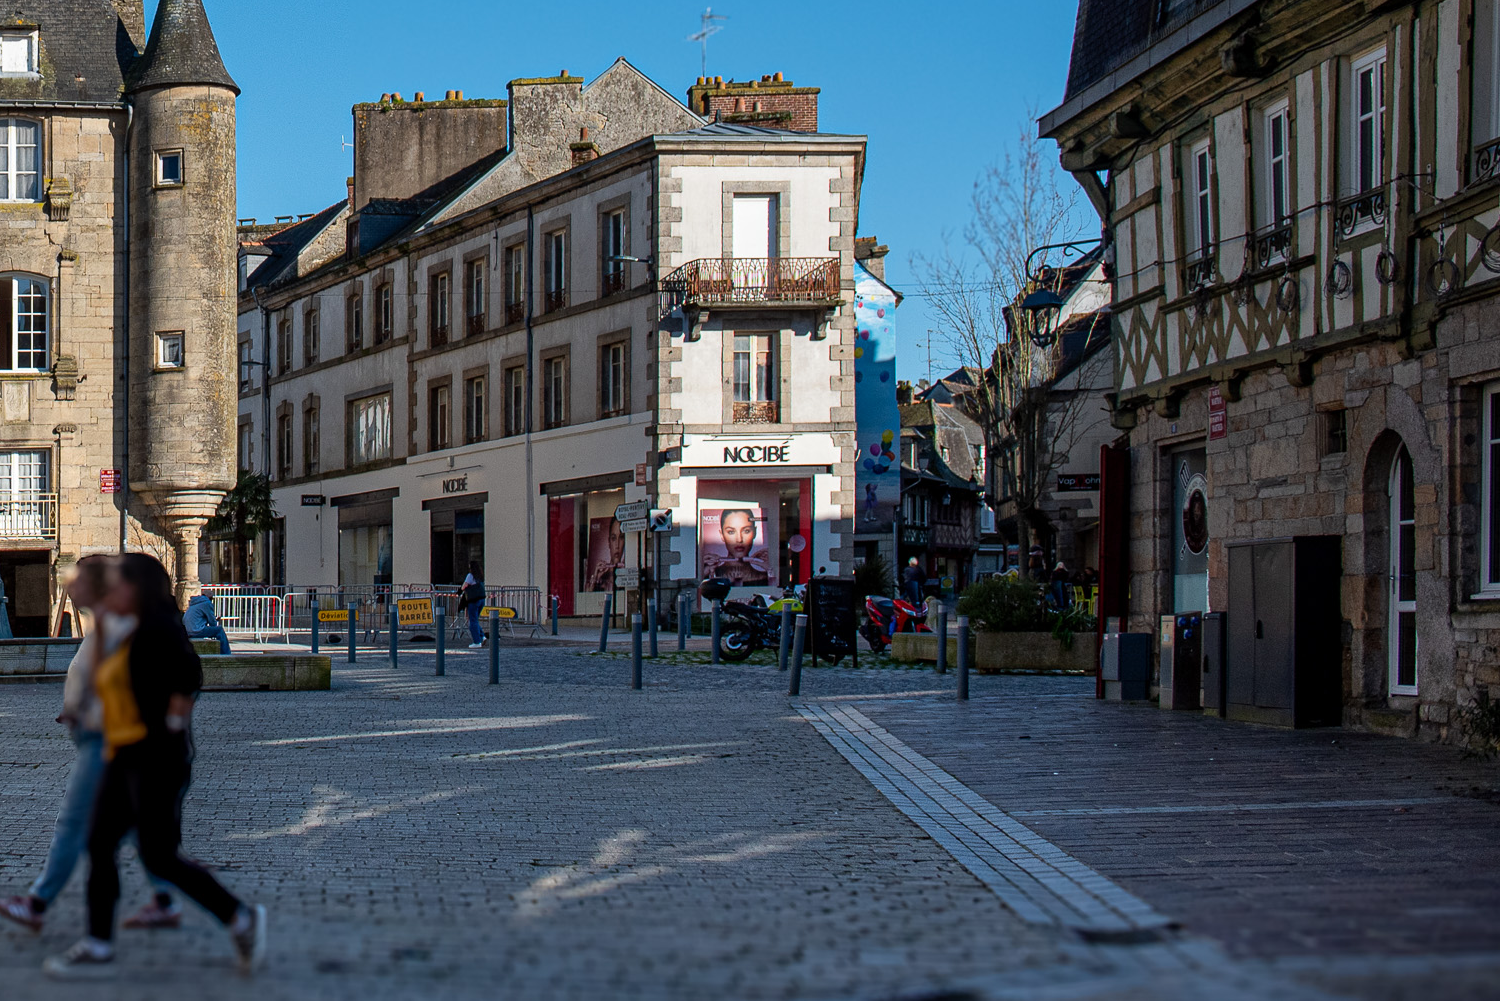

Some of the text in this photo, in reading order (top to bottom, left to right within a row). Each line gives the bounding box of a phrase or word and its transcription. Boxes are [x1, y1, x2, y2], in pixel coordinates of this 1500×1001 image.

[723, 440, 790, 463] NOCIBÉ
[442, 473, 468, 494] NOCIBÉ
[401, 602, 429, 611] ROUTE
[320, 611, 349, 620] Déviatio
[400, 611, 432, 622] BARRÉE
